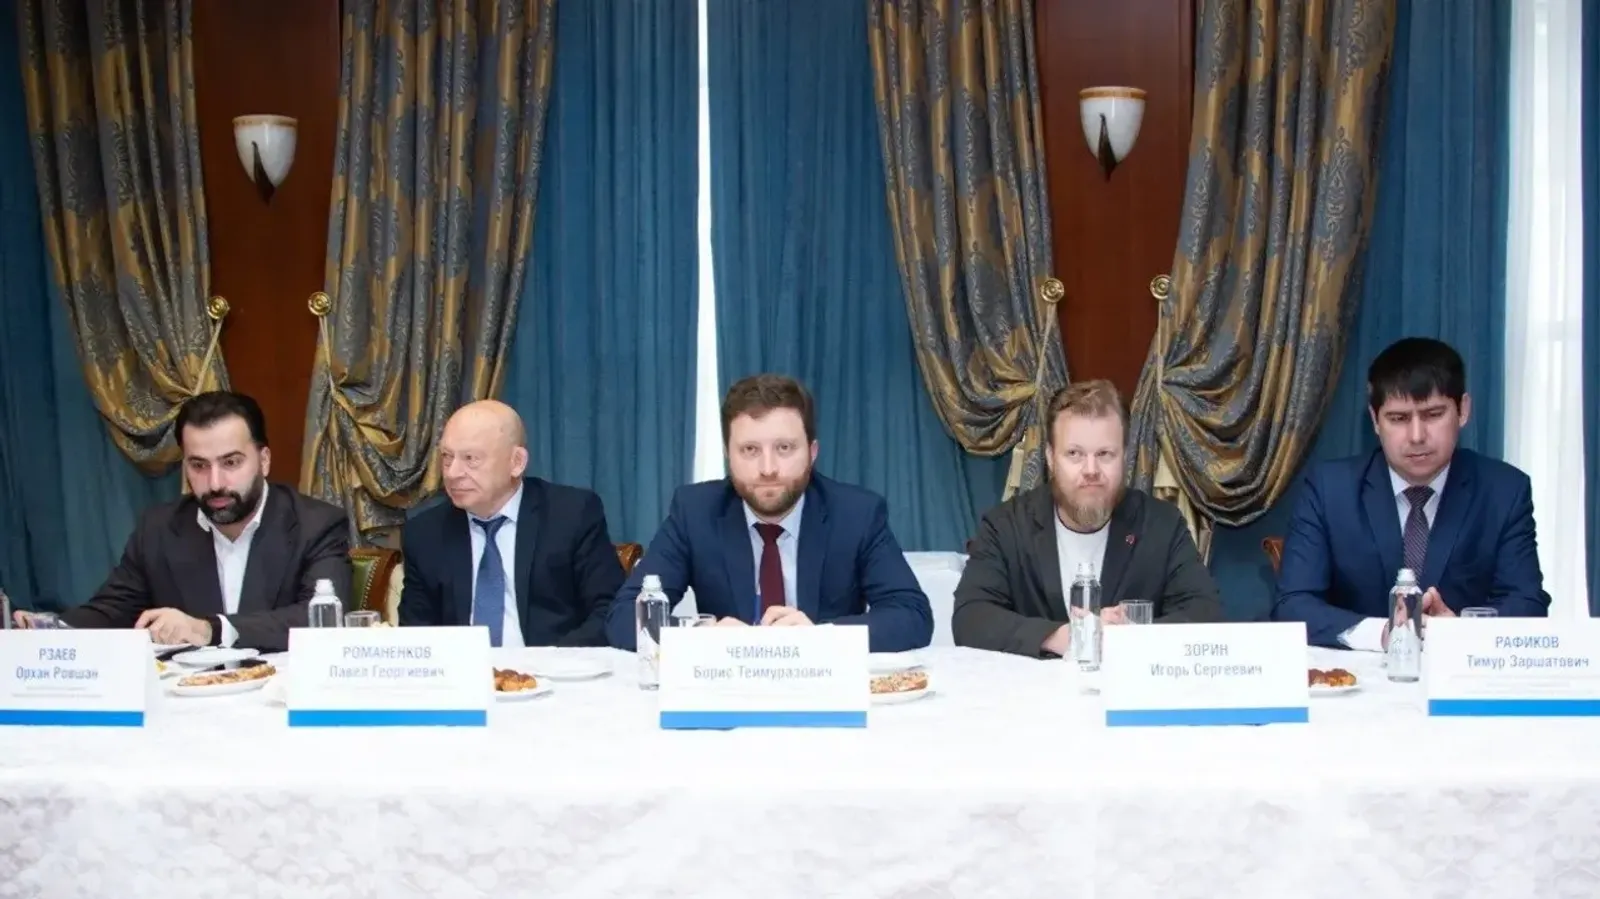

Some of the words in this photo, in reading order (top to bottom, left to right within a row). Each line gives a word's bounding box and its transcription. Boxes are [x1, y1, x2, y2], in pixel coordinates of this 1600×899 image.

[1495, 636, 1559, 648] РАФИКОВ
[39, 648, 76, 660] РЗАЕВ
[342, 646, 432, 659] РОМАНЕНКОВ
[726, 646, 800, 658] ЧЕМИНАВА
[1184, 643, 1229, 656] ЗОРИН
[1467, 655, 1505, 670] Тимур
[1510, 655, 1589, 669] Заршатович
[16, 666, 50, 680] Орхан
[53, 666, 98, 679] Ровшан
[329, 665, 368, 677] Павел
[372, 665, 445, 679] Георгиевич
[693, 665, 733, 679] Борис
[1150, 663, 1189, 678] Игорь
[1194, 663, 1262, 678] Сергеевич
